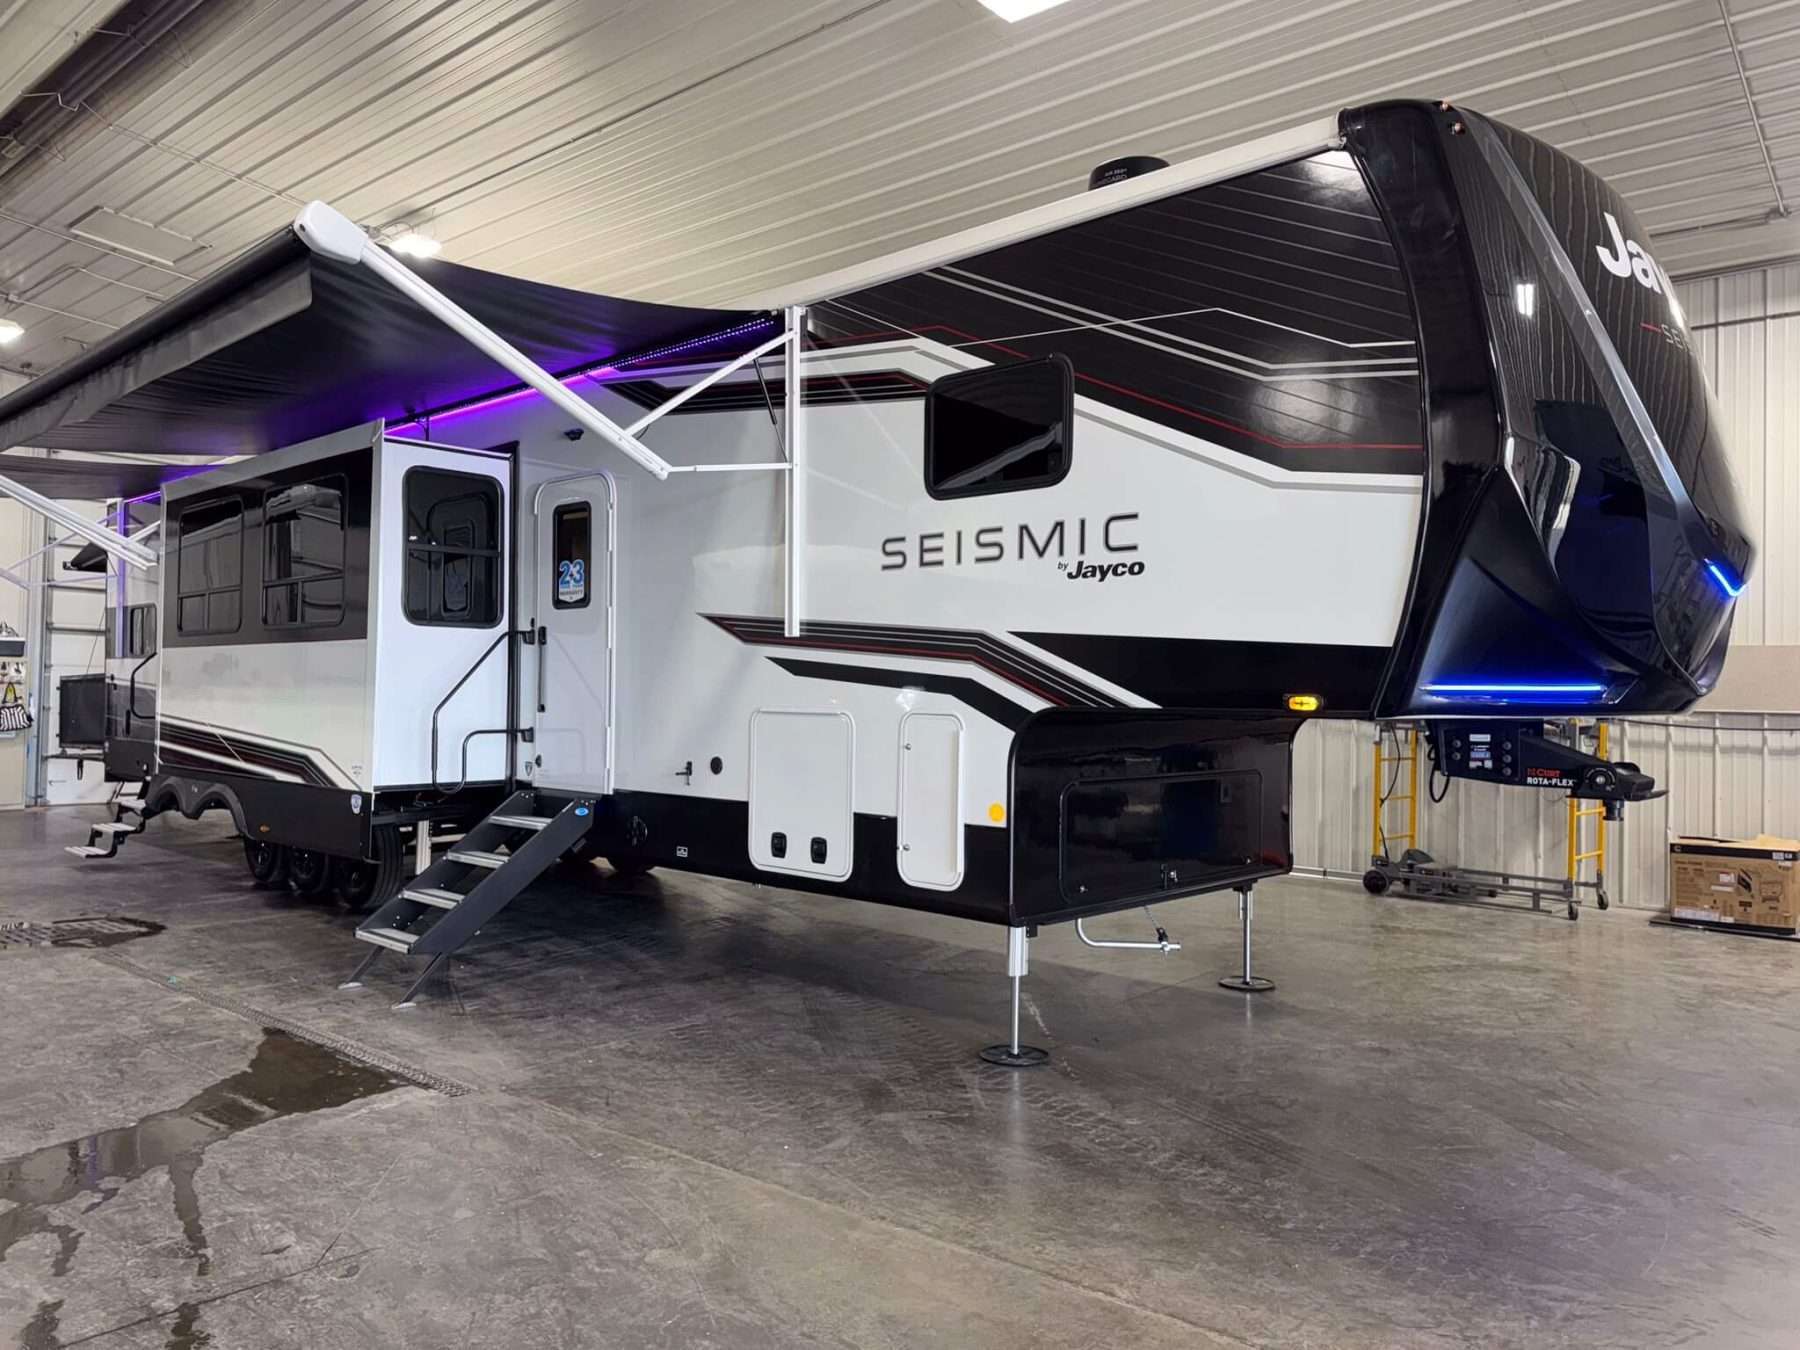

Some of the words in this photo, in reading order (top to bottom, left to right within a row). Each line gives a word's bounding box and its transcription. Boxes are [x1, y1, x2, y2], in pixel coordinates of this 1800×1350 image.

[881, 512, 1139, 571] SEISMIC
[1057, 560, 1068, 571] by
[1067, 560, 1145, 582] Jayco
[1526, 776, 1574, 787] ROTA-FLEX
